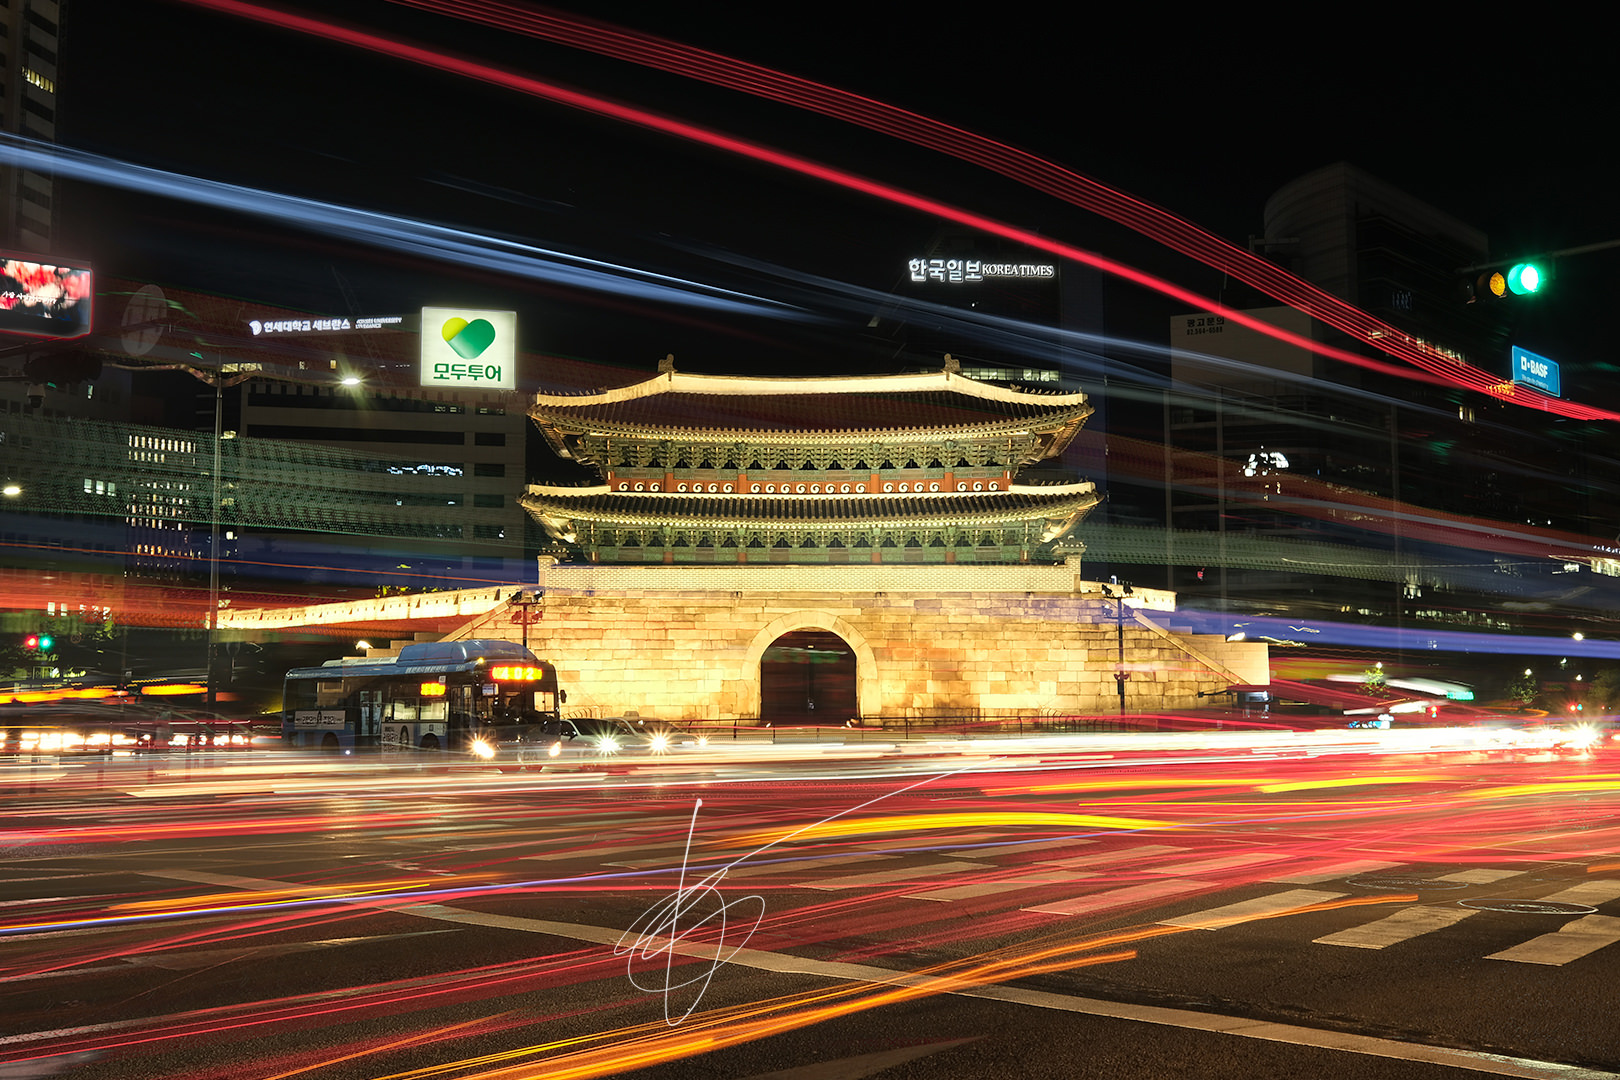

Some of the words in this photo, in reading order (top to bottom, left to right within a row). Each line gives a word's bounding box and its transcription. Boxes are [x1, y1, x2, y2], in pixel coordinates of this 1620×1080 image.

[909, 258, 983, 283] 한국일보
[982, 264, 1018, 277] KOREA
[1019, 265, 1054, 278] TIMES
[264, 320, 311, 332] 연세대학교
[313, 318, 350, 331] 세브란스
[433, 363, 501, 382] 모두투어
[1530, 360, 1548, 378] BASF
[501, 667, 535, 681] 402
